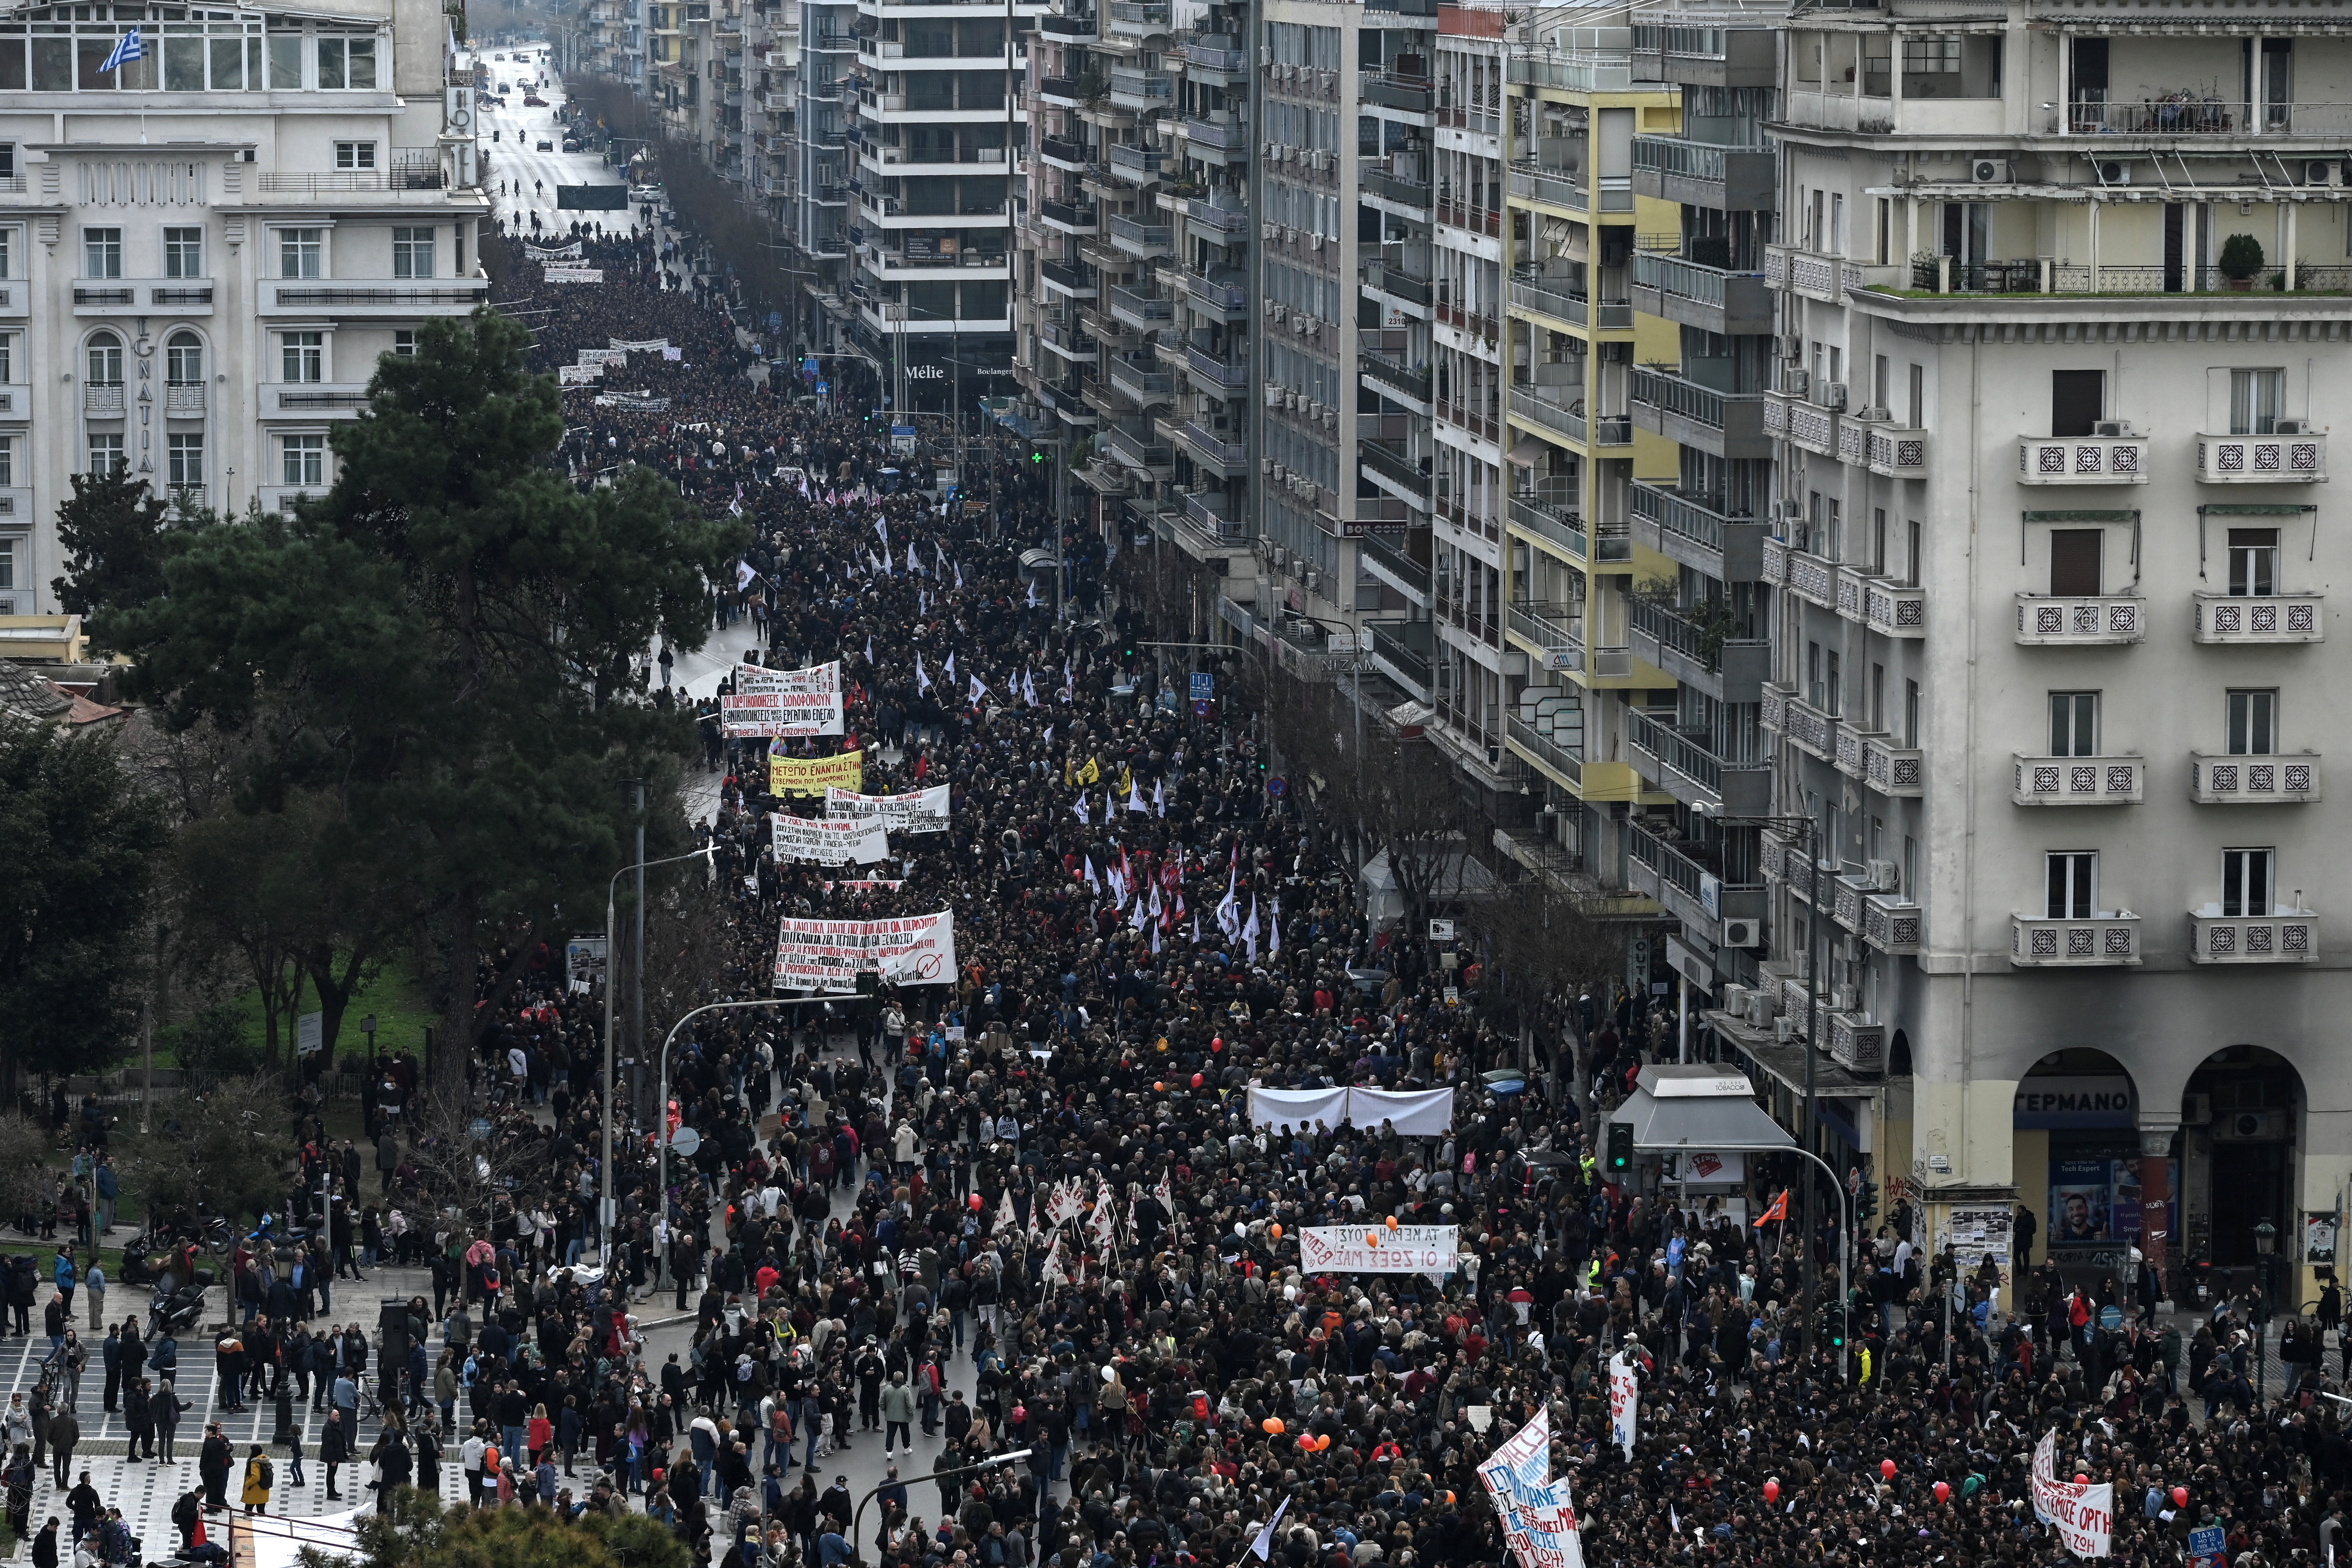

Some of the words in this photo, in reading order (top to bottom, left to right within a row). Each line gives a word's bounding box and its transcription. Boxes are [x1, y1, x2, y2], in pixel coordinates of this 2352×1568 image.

[904, 365, 944, 380] Mélie
[134, 316, 154, 472] EGNATIA
[723, 696, 730, 708] ΟΙ
[732, 694, 780, 708] ΙΔΙΩΤΙΚΟΠΟΙΗΣΕΙΣ
[783, 693, 831, 707] ΔΟΛΟΦΟΝΟΥΝ
[724, 709, 770, 723] ΕΘΝΙΚΟΠΟΙΗΣΕΙΣ
[783, 708, 811, 721] ΕΡΓΑΤΙΚΟ
[813, 708, 835, 720] ΕΛΕΓΧΟ
[724, 724, 758, 738] ΑΤΕΠΙΘΕΣΗ
[759, 724, 776, 736] ΤΩΝ
[776, 723, 819, 736] ΕΡΓΑΖΟΜΕΝΩΝ
[772, 766, 807, 776] ΜΕΤΩΠΟ
[810, 763, 842, 776] ΕΝΑΝΤΙΑ
[772, 776, 802, 784] ΚΥΒΕΡΝΗΣΗ
[831, 801, 855, 812] ΜΠΛΟΚΟ
[859, 802, 876, 811] ΣΤΗΝ
[908, 809, 936, 818] ΦΤΩΧΕΙΑΣ
[788, 817, 803, 826] ΖΩΕΣ
[821, 822, 853, 831] ΜΕΤΡΑΝΕ
[788, 826, 801, 835] ΣΤΗΝ
[802, 829, 823, 839] ΑΚΡΙΒΕΙΑ
[843, 823, 883, 840] ΙΔΙΩΤΙΚΟΠΟΙΗΣΕΙΣ
[776, 834, 801, 844] ΔΗΜΟΣΙΑ
[803, 837, 821, 846] ΔΩΡΕΑΝ
[777, 843, 806, 855] ΠΡΟΣΛΗΨΕΙΣ
[810, 848, 833, 857] ΑΥΞΗΣΕΙΣ
[838, 849, 849, 858] ΣΣΕ
[783, 920, 790, 930] ΤΑ
[794, 921, 824, 934] ΙΔΙΩΤΙΚΑ
[828, 922, 874, 935] ΠΑΝΕΠΙΣΤΗΜΙΑ
[876, 922, 888, 934] ΔΕΝ
[891, 921, 901, 933] ΘΑ
[903, 916, 938, 932] ΠΕΡΑΣΟΥΝ
[782, 932, 789, 943] ΤΟ
[789, 932, 821, 945] ΕΓΚΛΗΜΑ
[822, 935, 833, 946] ΣΤΑ
[835, 934, 858, 948] ΤΕΜΠΗ
[872, 935, 880, 946] ΘΑ
[780, 944, 795, 954] ΚΑΤΩ
[797, 945, 802, 954] Η
[803, 945, 841, 957] ΚΥΒΕΡΝΗΣΗ
[844, 949, 870, 959] ΦΤΩΧΕΙΑΣ
[778, 954, 806, 964] ΑΥΞΗΣΕΙΣ
[818, 956, 845, 968] ΜΙΣΘΟΥΣ
[852, 959, 864, 969] ΣΣΕ
[865, 958, 880, 969] ΤΩΡΑ
[777, 963, 782, 973] Η
[784, 963, 824, 976] ΤΡΟΜΟΚΡΑΤΙΑ
[827, 967, 841, 976] ΔΕΝ
[843, 968, 856, 977] ΜΑΣ
[999, 1123, 1015, 1131] EXPLORE
[2079, 1506, 2113, 1534] ΟΡΓΗ
[2074, 1533, 2095, 1554] ΖΩΗ
